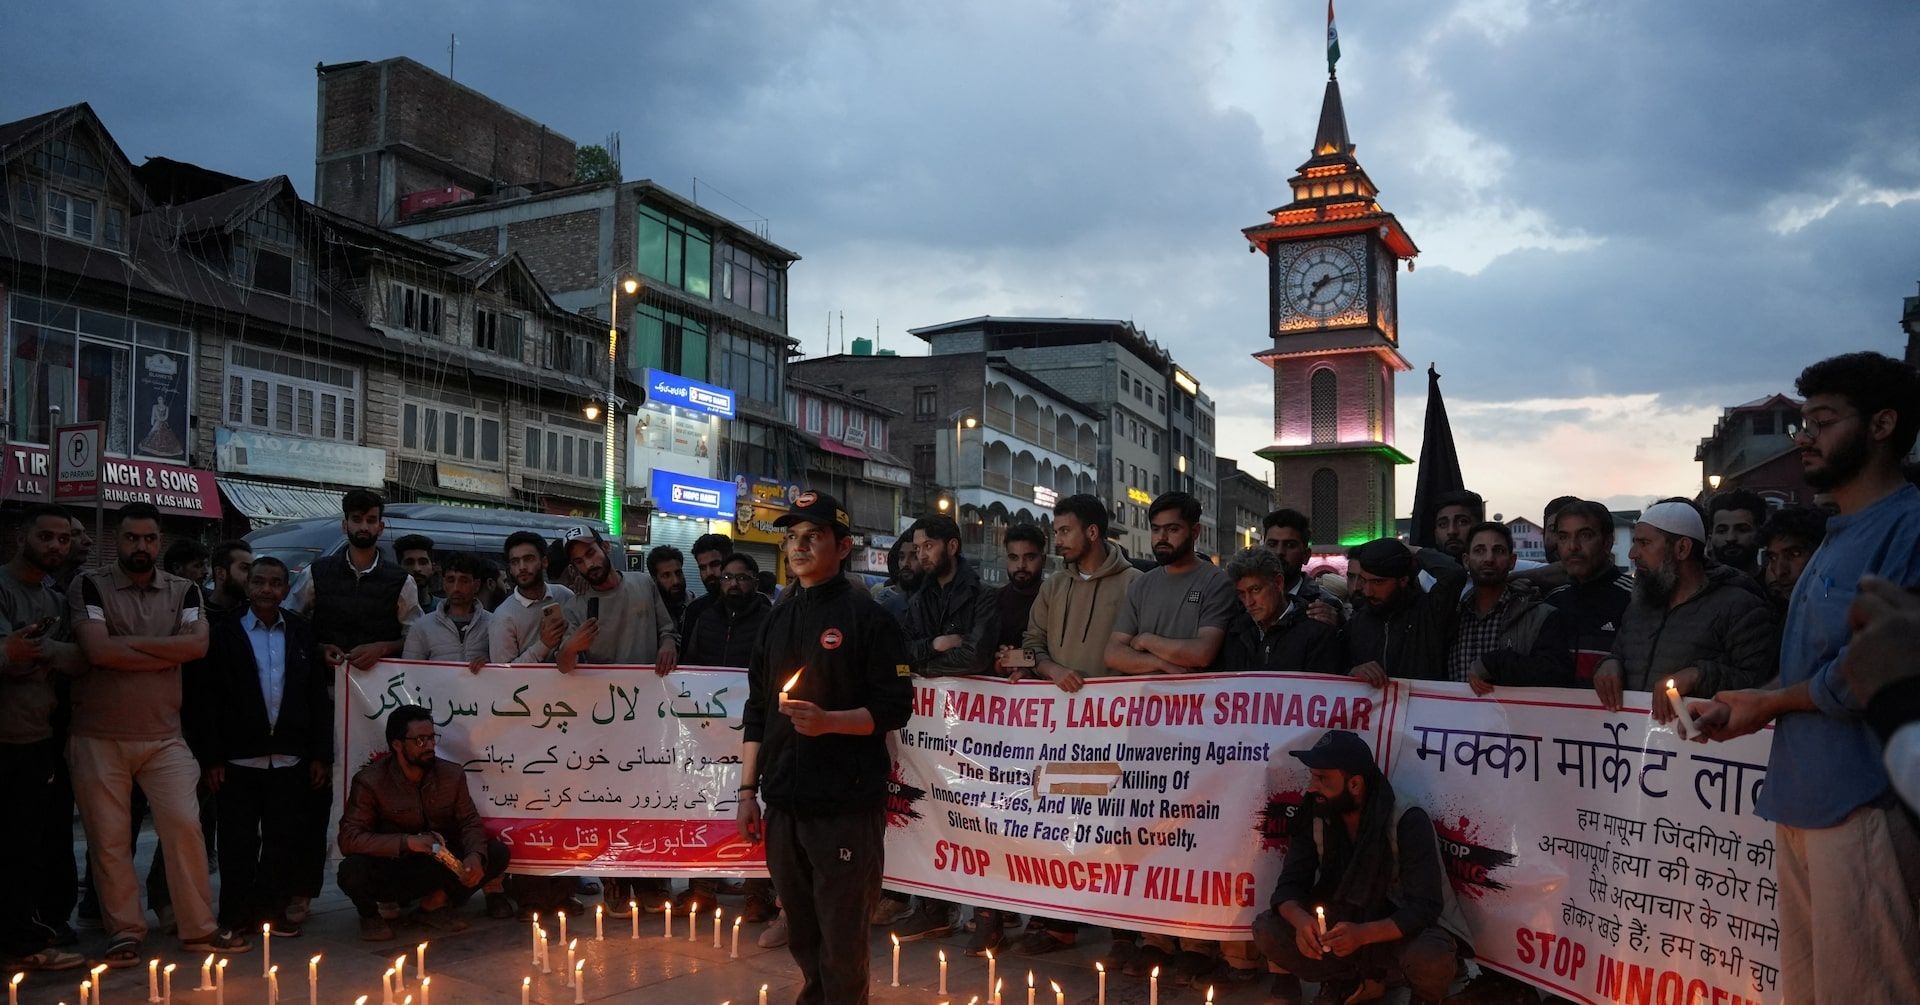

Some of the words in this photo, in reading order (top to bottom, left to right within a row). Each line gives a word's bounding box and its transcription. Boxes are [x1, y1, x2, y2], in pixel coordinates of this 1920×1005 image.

[15, 451, 49, 476] TIR
[103, 463, 141, 486] INGH
[147, 468, 157, 487] &
[161, 470, 199, 493] SONS
[61, 471, 69, 479] NO
[70, 470, 95, 479] PARKING
[18, 480, 42, 494] LAL
[103, 489, 151, 504] RINAGAR
[156, 494, 202, 510] KASHMIR
[631, 557, 639, 567] P
[491, 685, 577, 734] چوک
[592, 683, 639, 725] لال
[944, 689, 1057, 734] MARKET,
[1066, 693, 1206, 728] LALCHOWK
[1213, 692, 1373, 731] SRINAGAR
[523, 745, 558, 774] کے
[567, 747, 610, 771] خون
[618, 746, 676, 772] انسانی
[684, 754, 743, 772] عصوم
[900, 728, 914, 746] We
[918, 731, 958, 756] Firmly
[962, 737, 1034, 760] Condemn
[1038, 743, 1067, 762] And
[1071, 743, 1111, 762] Stand
[1116, 742, 1200, 765] Unwavering
[1205, 741, 1270, 765] Against
[1413, 726, 1543, 781] मक्का
[1553, 722, 1677, 797] मार्केट
[957, 762, 984, 780] The
[990, 766, 1036, 787] Brutal
[1122, 771, 1167, 793] Killing
[1172, 770, 1190, 790] Of
[525, 787, 572, 810] کرتے
[578, 787, 622, 803] مذمت
[684, 788, 708, 809] کی
[931, 783, 986, 807] Innocent
[990, 791, 1032, 815] Lives,
[1037, 795, 1063, 814] And
[1071, 797, 1092, 815] We
[1097, 797, 1125, 818] Will
[1129, 799, 1155, 818] Not
[1159, 800, 1220, 820] Remain
[524, 830, 554, 851] بند
[563, 826, 599, 850] قتل
[608, 827, 630, 847] کا
[639, 823, 708, 856] گناہوں
[947, 810, 982, 833] Silent
[985, 817, 998, 835] In
[1004, 819, 1028, 838] The
[1033, 822, 1070, 841] Face
[1075, 825, 1091, 843] Of
[1095, 825, 1132, 845] Such
[1138, 827, 1197, 852] Cruelty.
[1577, 808, 1600, 832] हम
[1604, 814, 1647, 846] मासूम
[1654, 817, 1741, 861] जिंदगियों
[1747, 839, 1775, 870] की
[934, 839, 991, 877] STOP
[1005, 853, 1139, 897] INNOCENT
[1144, 865, 1256, 907] KILLING
[1538, 836, 1610, 871] अन्यायपूर्ण
[1612, 851, 1651, 878] हत्या
[1658, 857, 1689, 886] की
[1695, 868, 1751, 902] कठोर
[1590, 871, 1607, 902] ऐसे
[1611, 887, 1694, 922] अत्याचार
[1700, 898, 1721, 930] के
[1727, 912, 1780, 951] सामने
[1516, 927, 1586, 981] STOP
[1562, 898, 1595, 932] होकर
[1598, 914, 1622, 947] खड़े
[1660, 932, 1695, 960] हम
[1699, 942, 1744, 977] कभी
[1749, 959, 1779, 992] चुप
